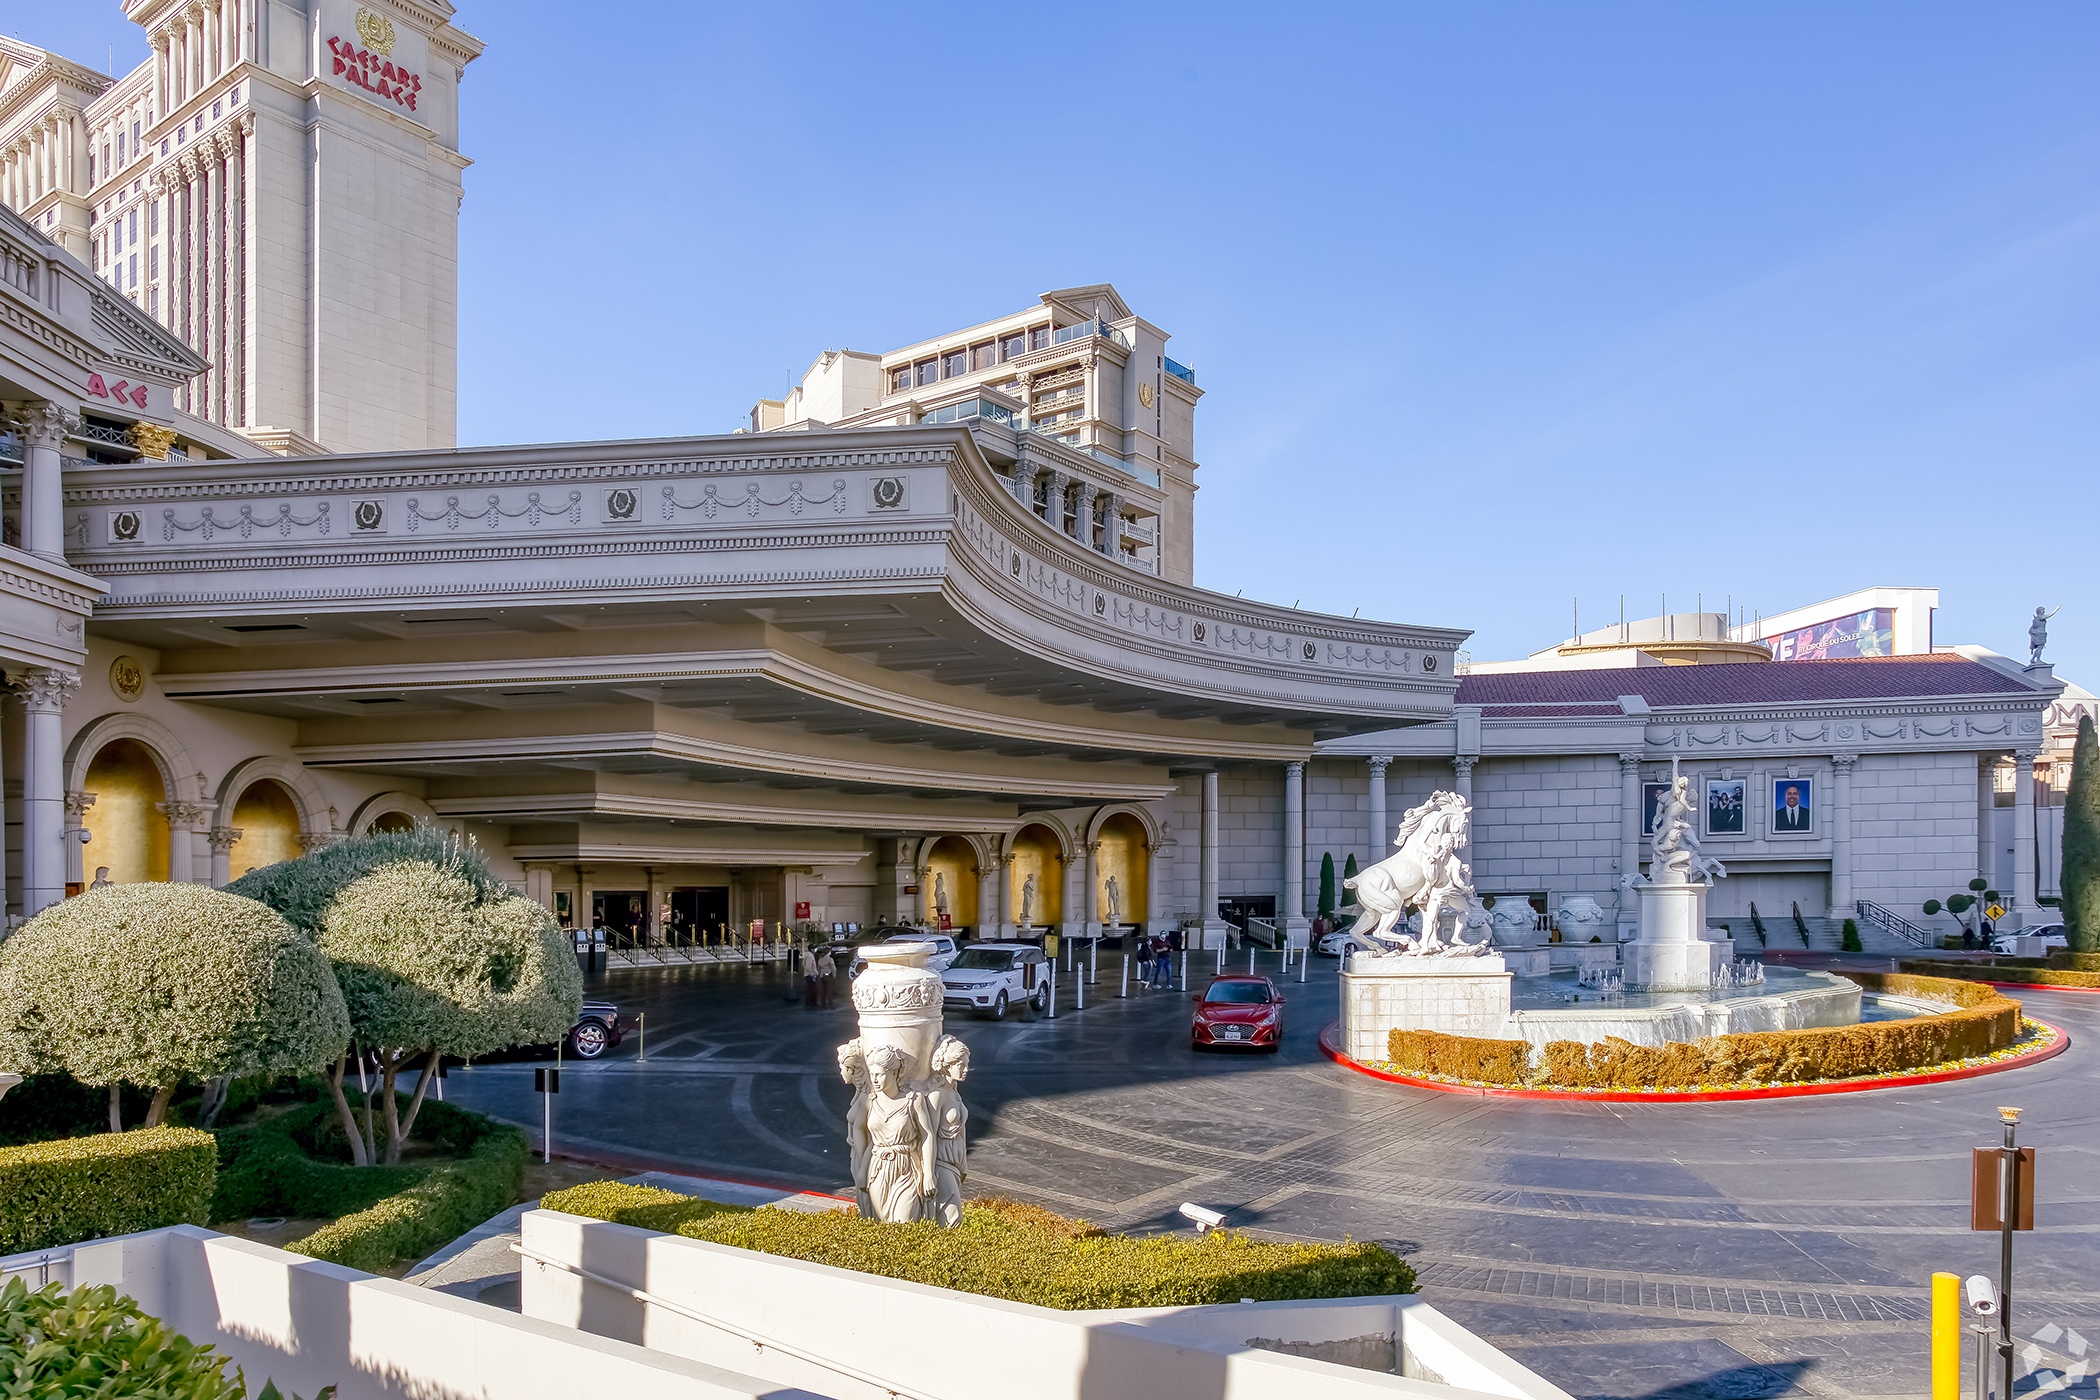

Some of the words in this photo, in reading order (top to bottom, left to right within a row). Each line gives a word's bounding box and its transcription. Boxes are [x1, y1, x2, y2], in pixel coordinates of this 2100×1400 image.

[327, 36, 422, 93] CAESARS
[333, 56, 417, 112] PALACE
[1798, 646, 1806, 654] BY
[1805, 639, 1829, 651] CIRQUE
[1829, 637, 1839, 646] DU
